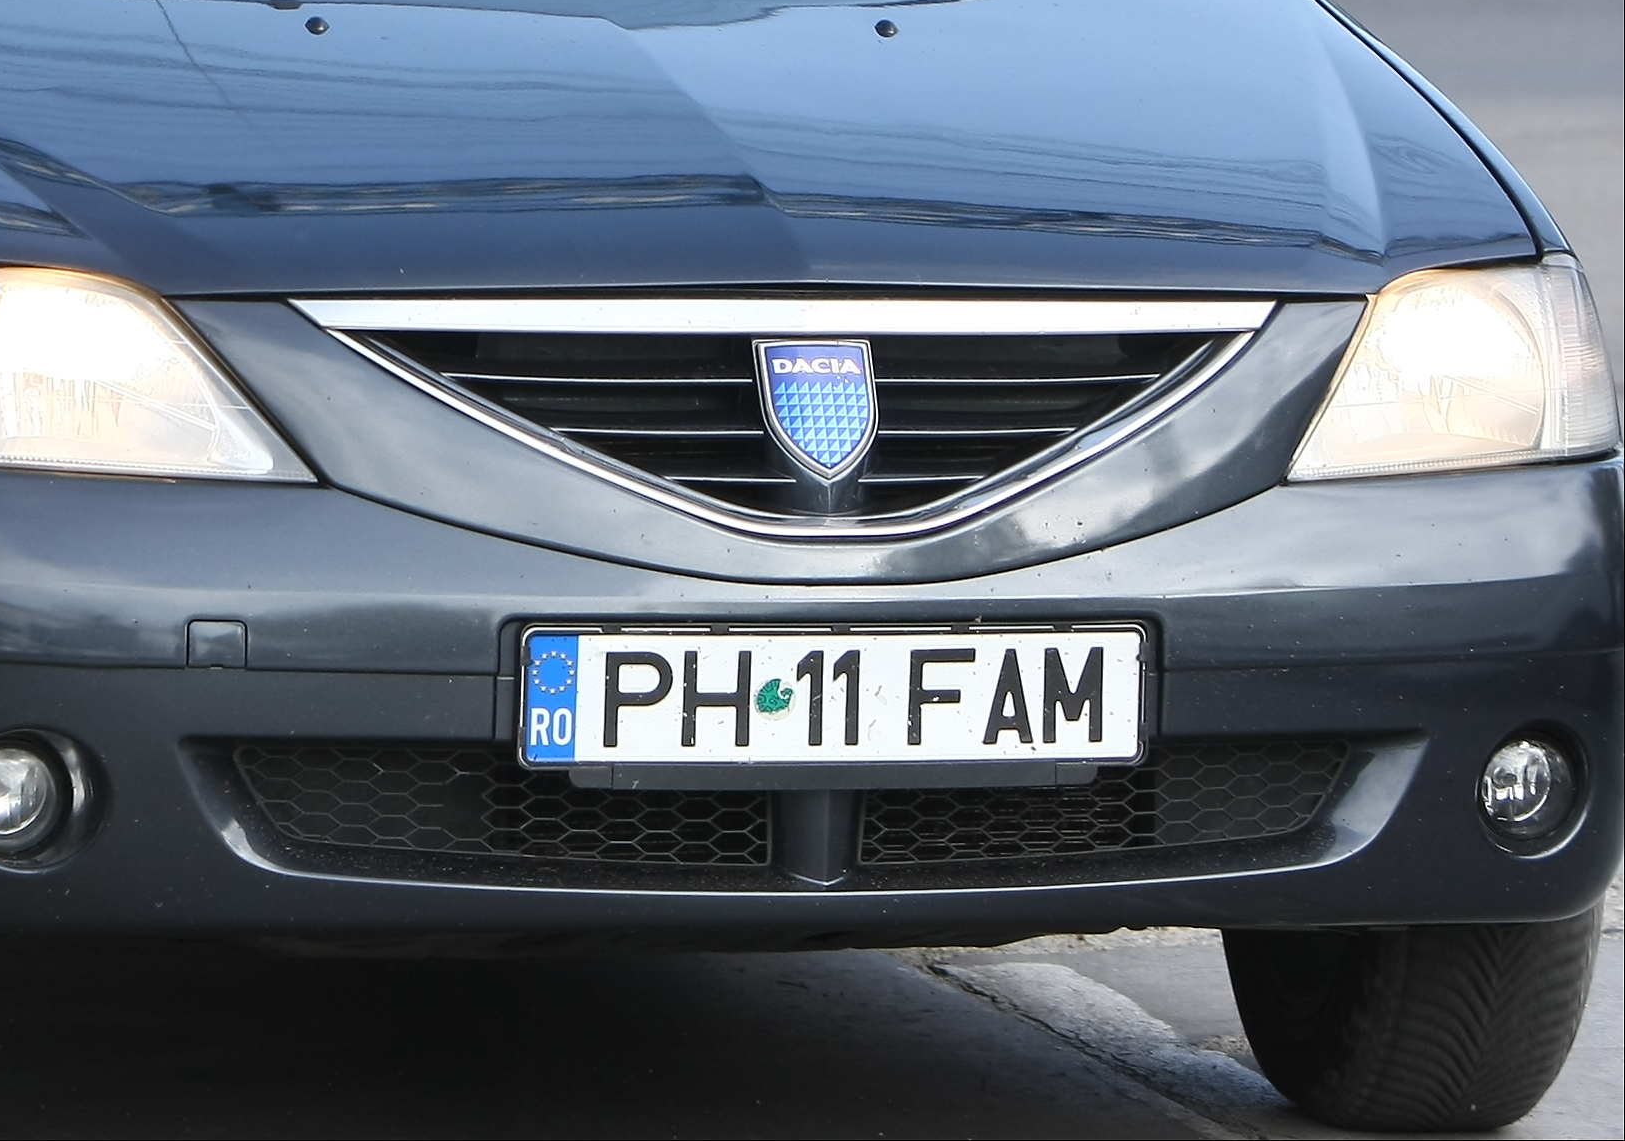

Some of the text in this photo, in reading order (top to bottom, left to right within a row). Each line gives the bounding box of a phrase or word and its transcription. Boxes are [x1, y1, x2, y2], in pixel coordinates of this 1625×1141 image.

[771, 358, 862, 374] DACIA
[602, 647, 1105, 747] PH 11 FAM
[529, 707, 573, 746] RO
